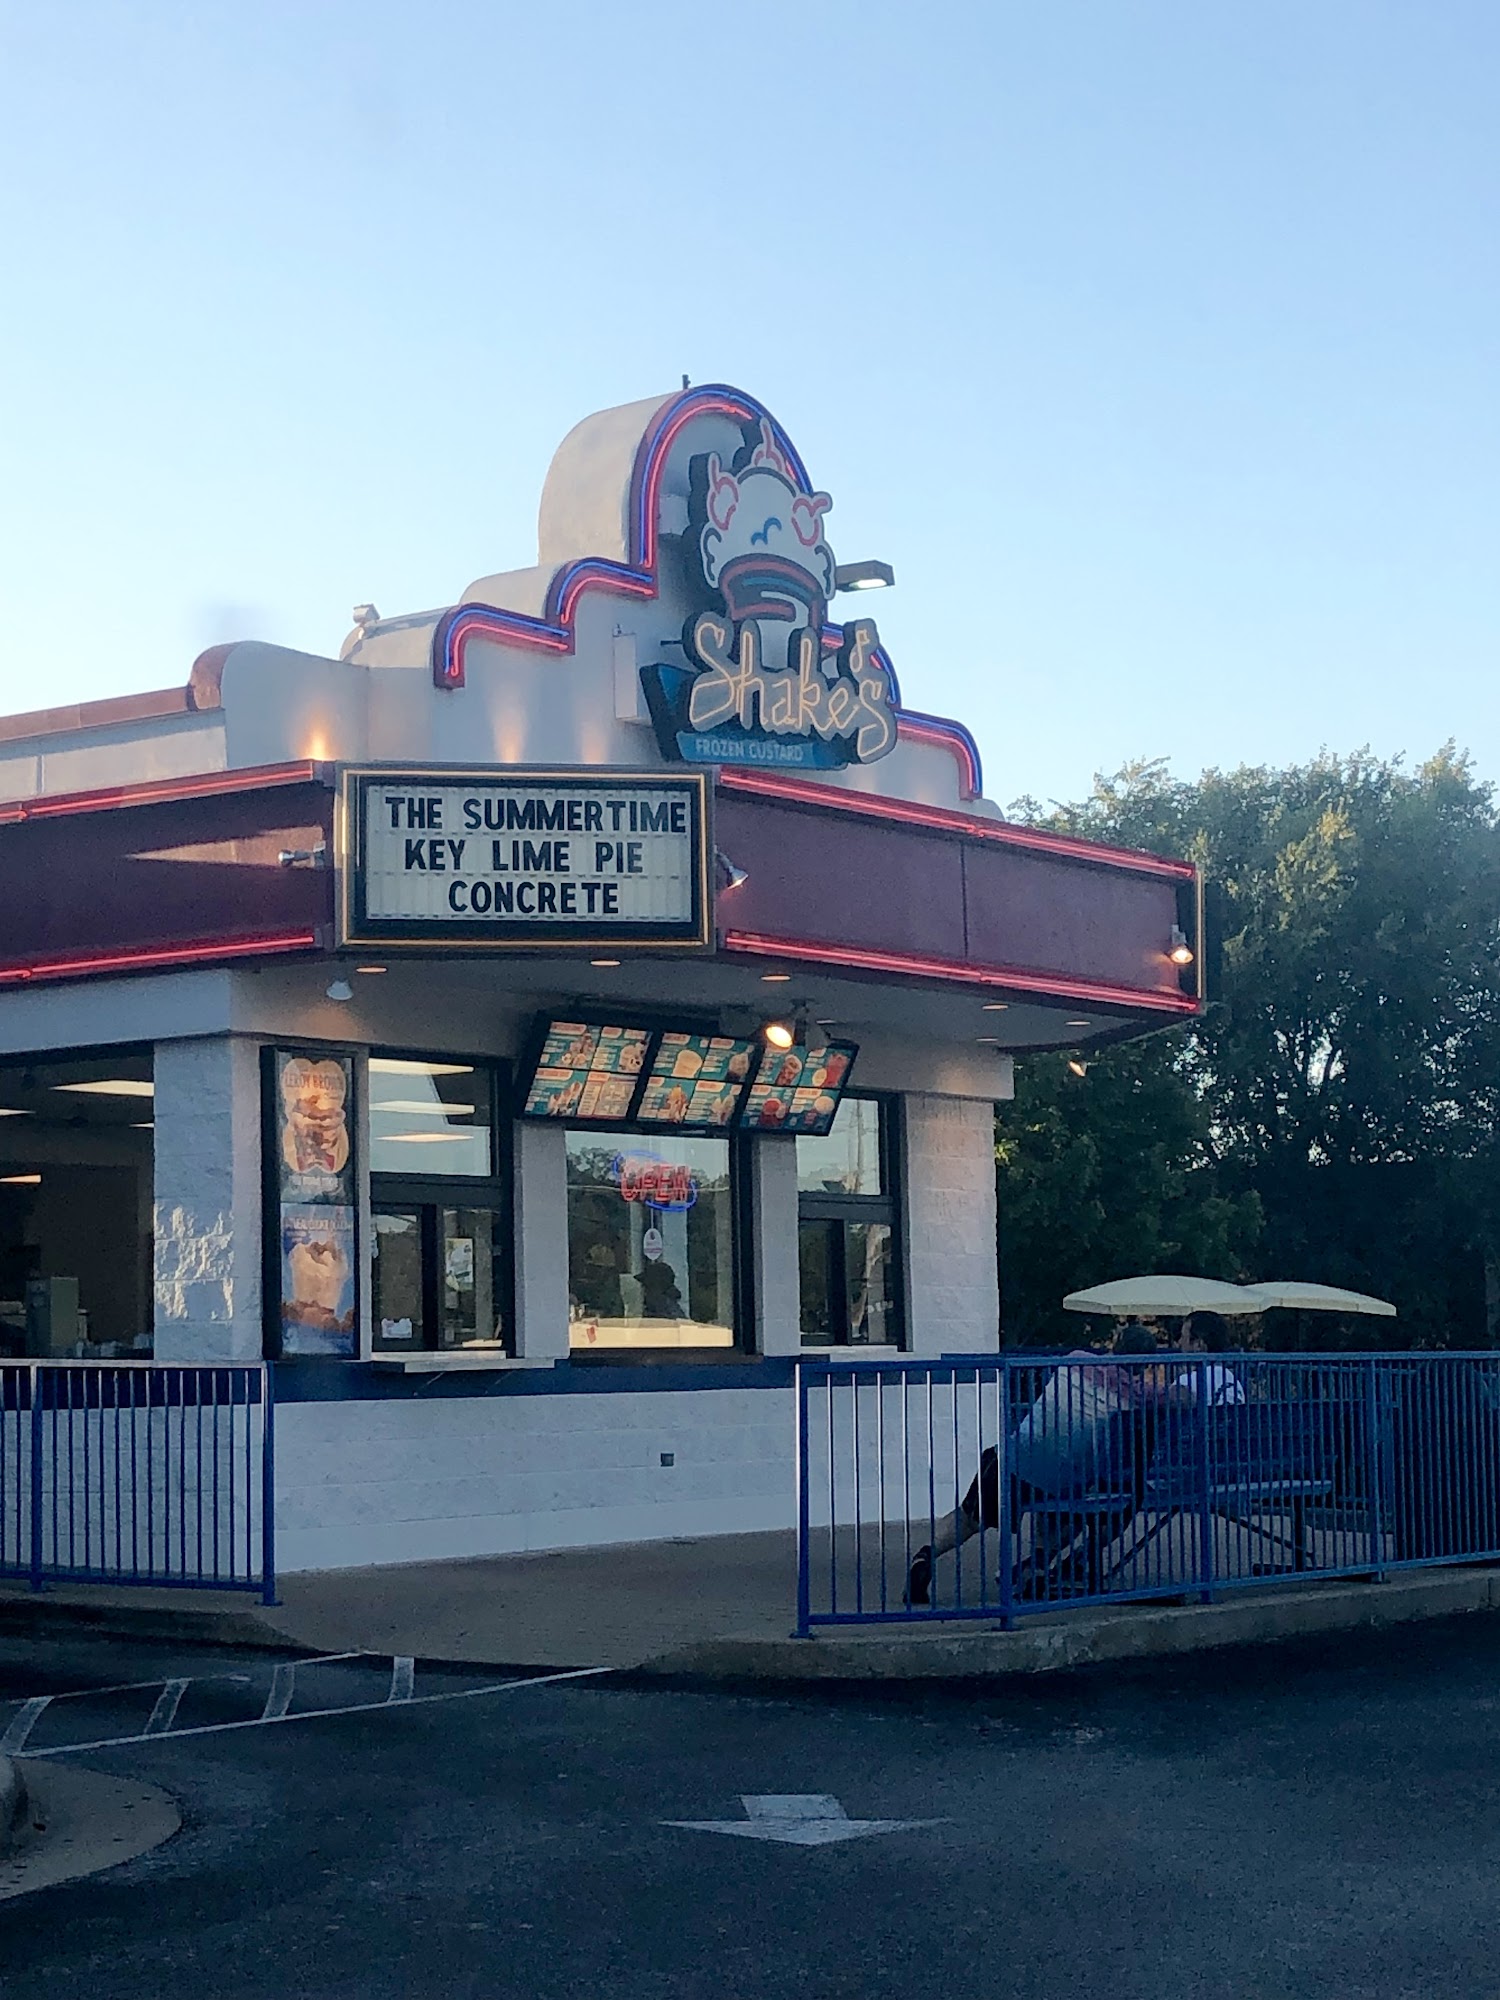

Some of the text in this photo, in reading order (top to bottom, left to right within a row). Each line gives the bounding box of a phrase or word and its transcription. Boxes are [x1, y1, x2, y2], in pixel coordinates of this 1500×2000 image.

[689, 616, 893, 761] Shake's
[695, 738, 804, 762] FROZEN CUSTARD
[385, 796, 686, 833] THE SUMMERTIME
[404, 839, 644, 873] KEY LIME PIE
[448, 880, 619, 914] CONCRETE
[621, 1158, 692, 1202] OPEN
